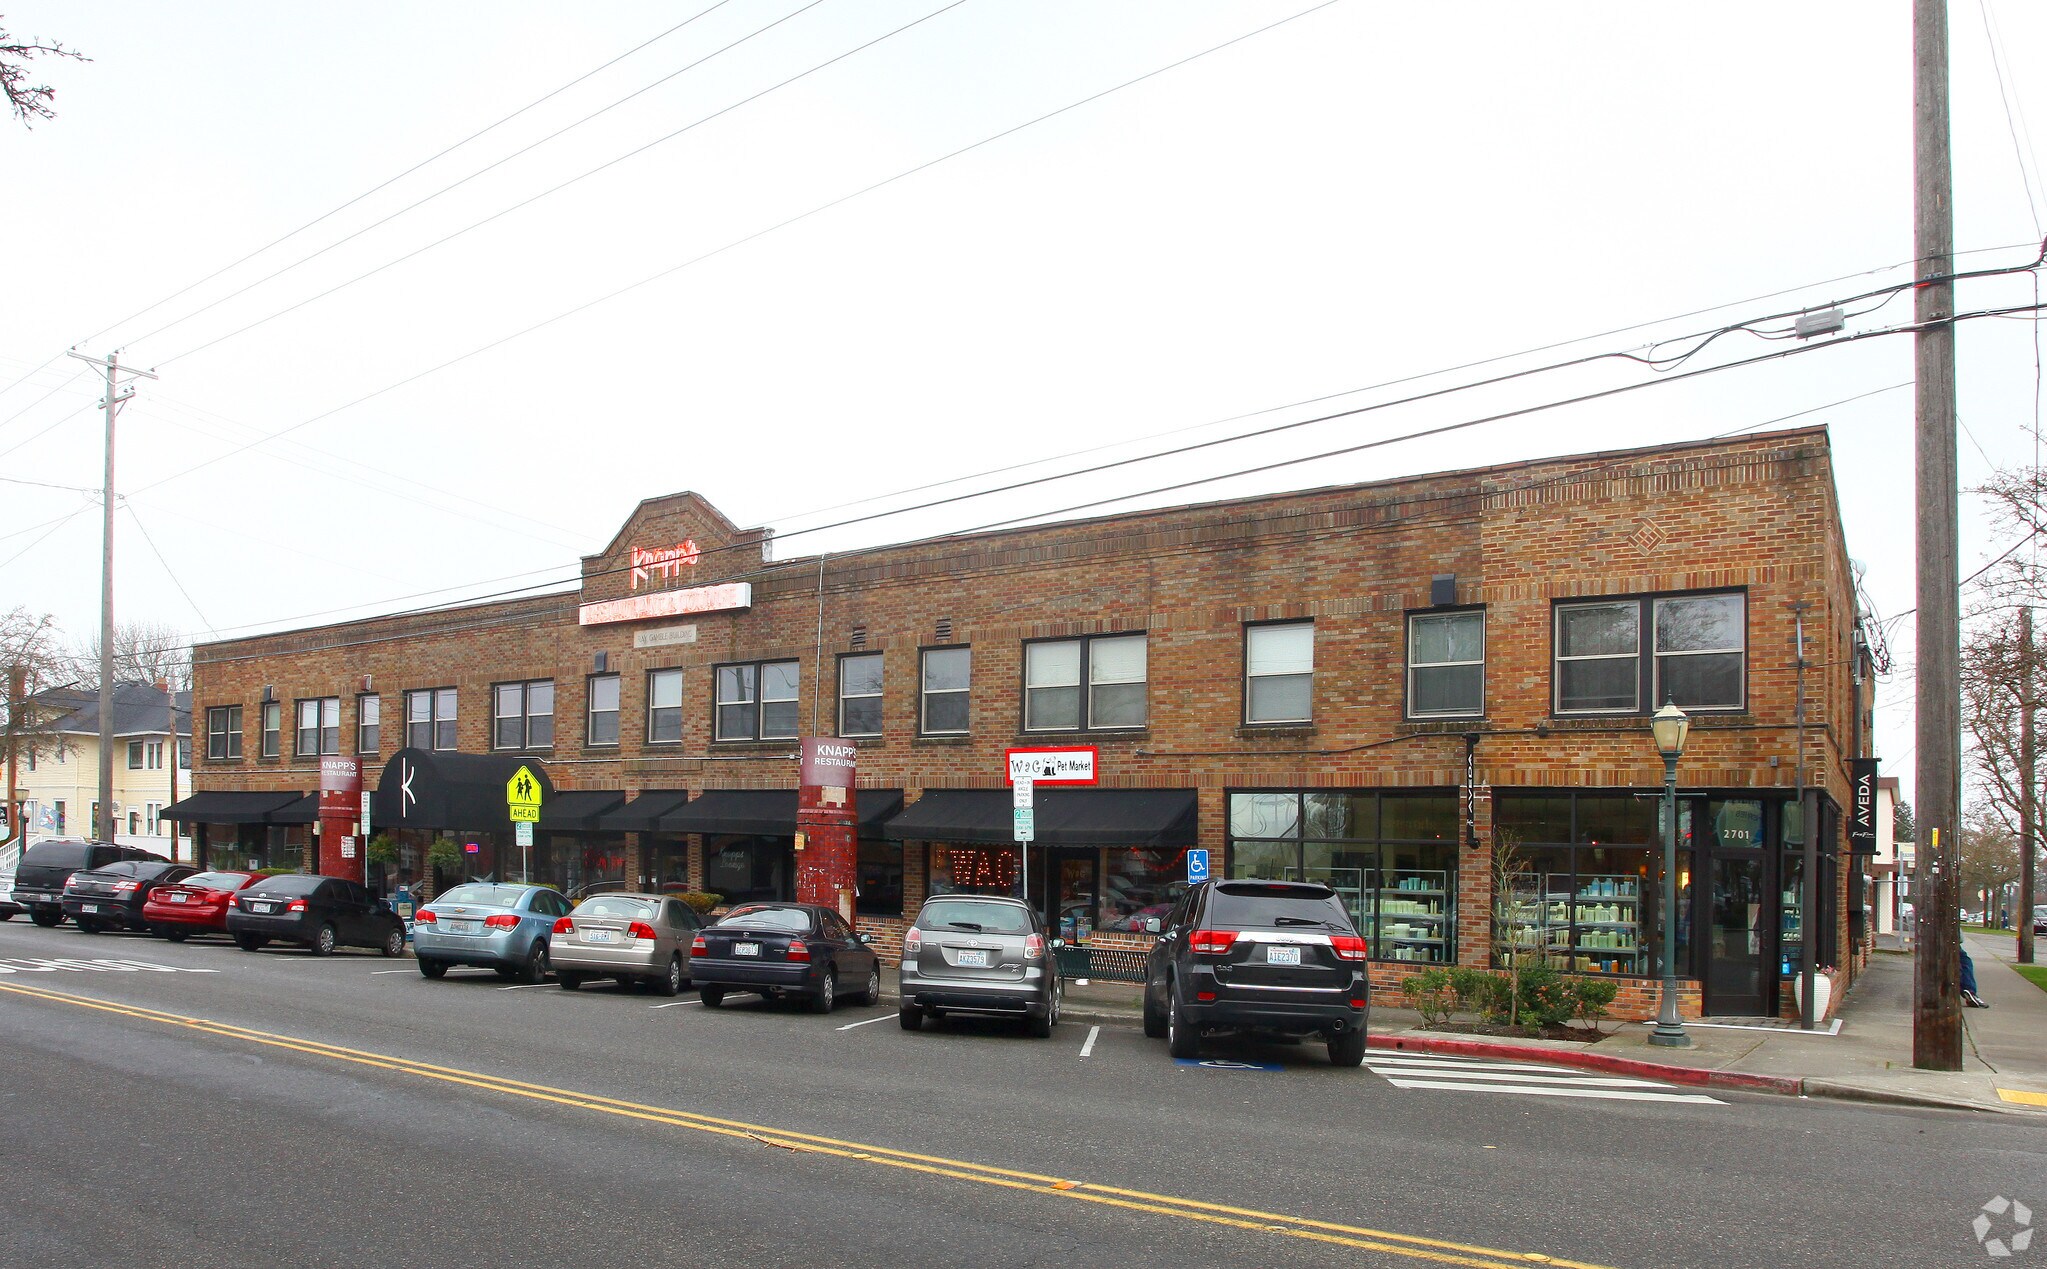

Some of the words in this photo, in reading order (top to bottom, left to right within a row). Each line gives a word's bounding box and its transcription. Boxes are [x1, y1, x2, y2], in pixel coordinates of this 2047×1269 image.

[630, 539, 701, 589] Knapp's
[817, 744, 857, 759] KNAPP'S
[322, 761, 357, 771] KNAPP'S
[1057, 760, 1067, 771] Pet
[1069, 760, 1091, 771] Market
[401, 757, 417, 818] K
[1857, 773, 1871, 828] AVEDA
[513, 809, 537, 818] AHEAD
[1724, 829, 1749, 840] 2701
[950, 850, 1019, 887] WAG
[1269, 952, 1299, 963] AIE2370
